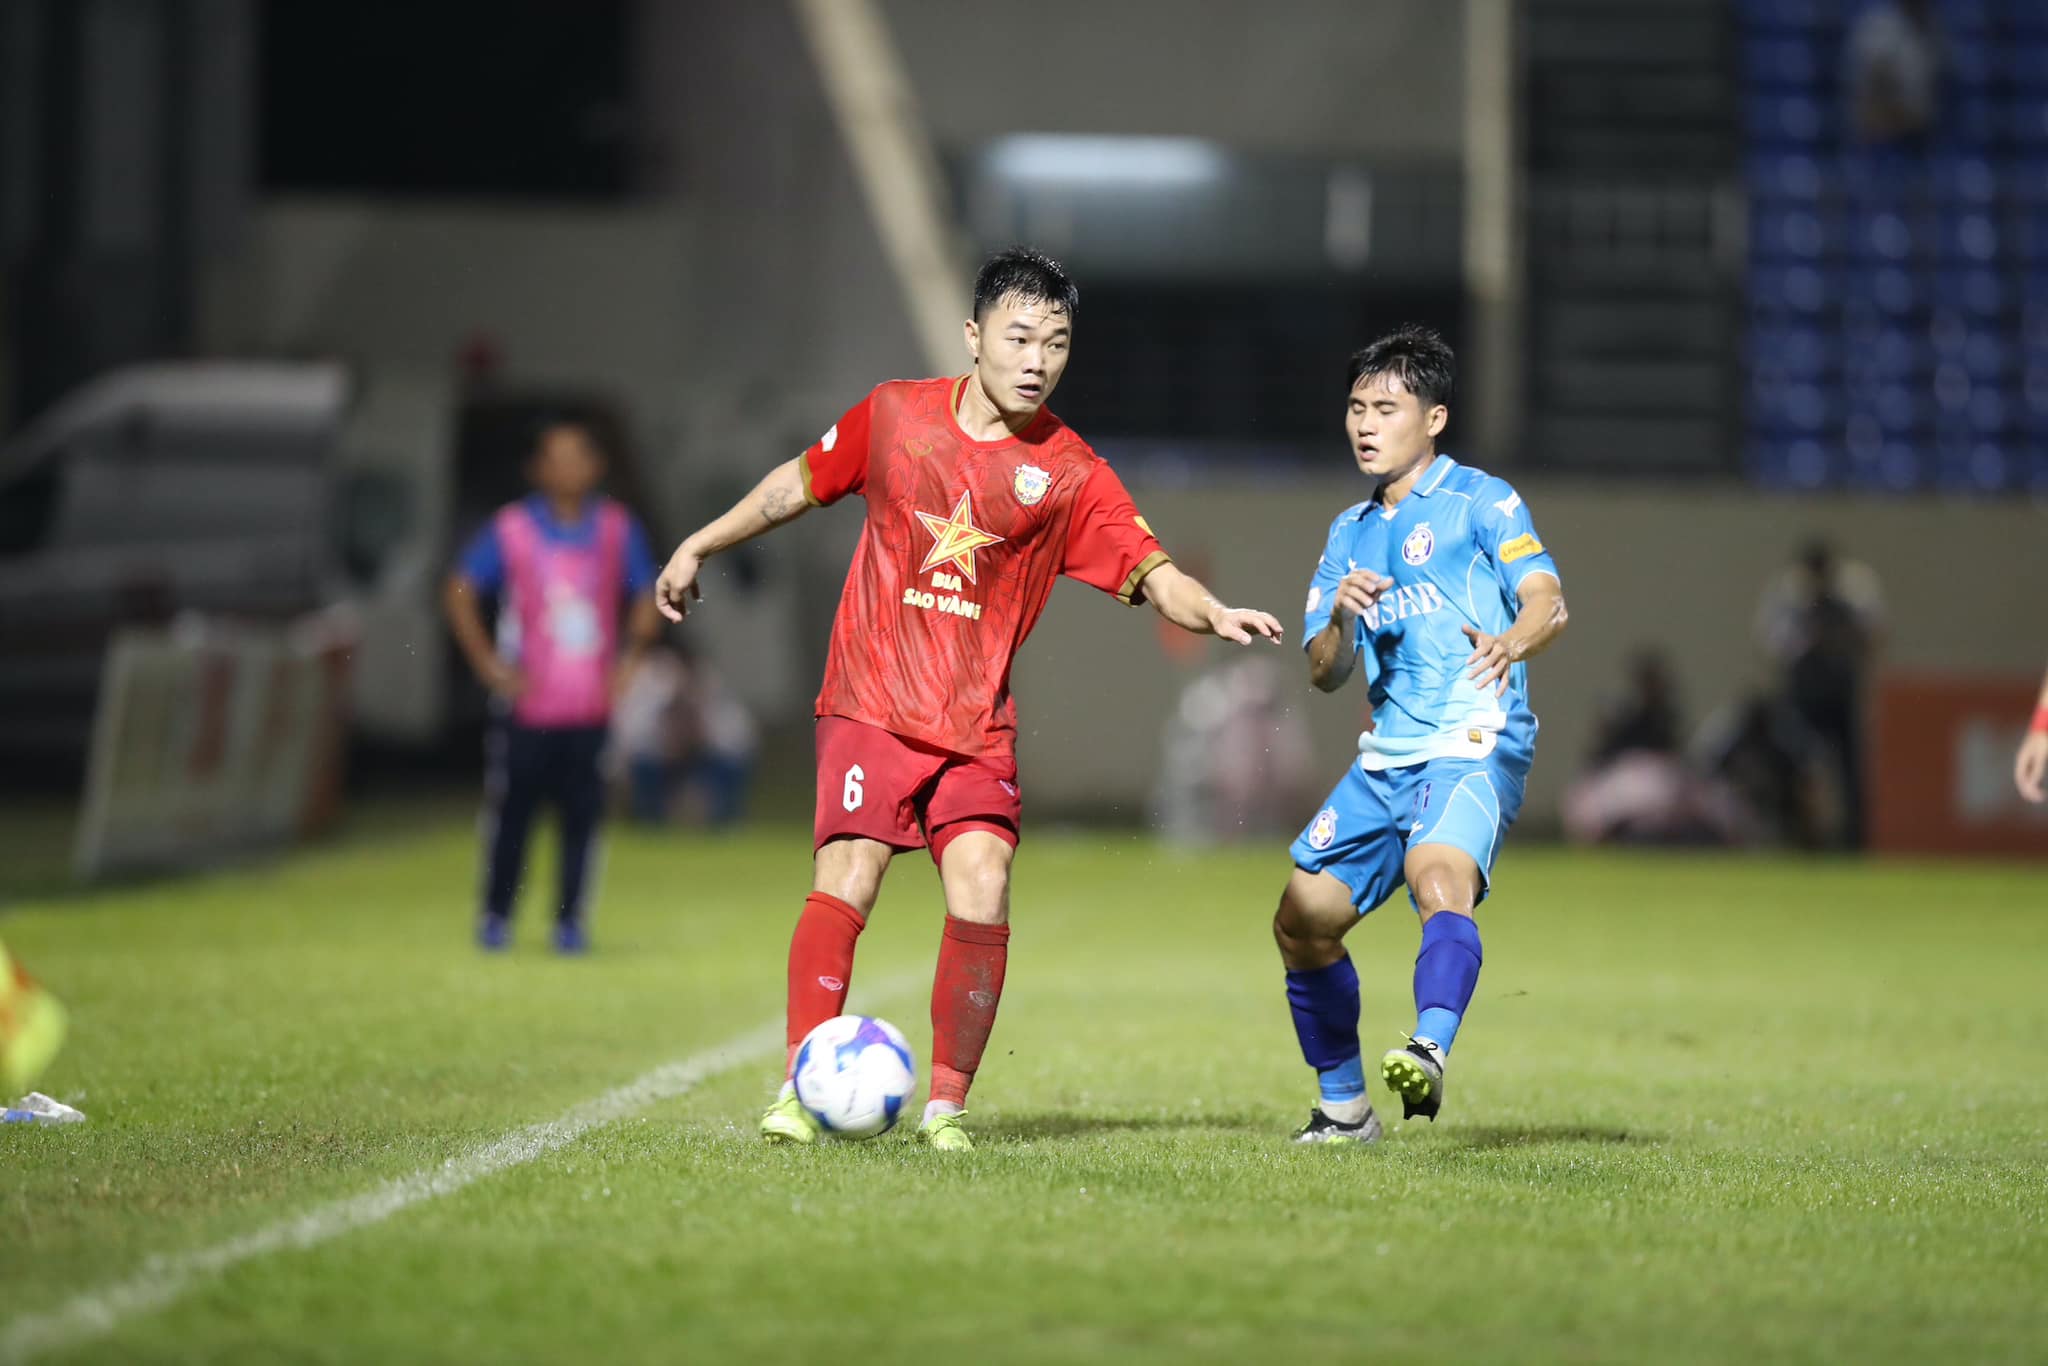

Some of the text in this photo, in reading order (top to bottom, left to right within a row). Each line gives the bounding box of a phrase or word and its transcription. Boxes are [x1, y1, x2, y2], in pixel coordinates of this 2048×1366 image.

[931, 571, 962, 592] BIA
[903, 587, 935, 609] SAO
[842, 763, 865, 813] 6
